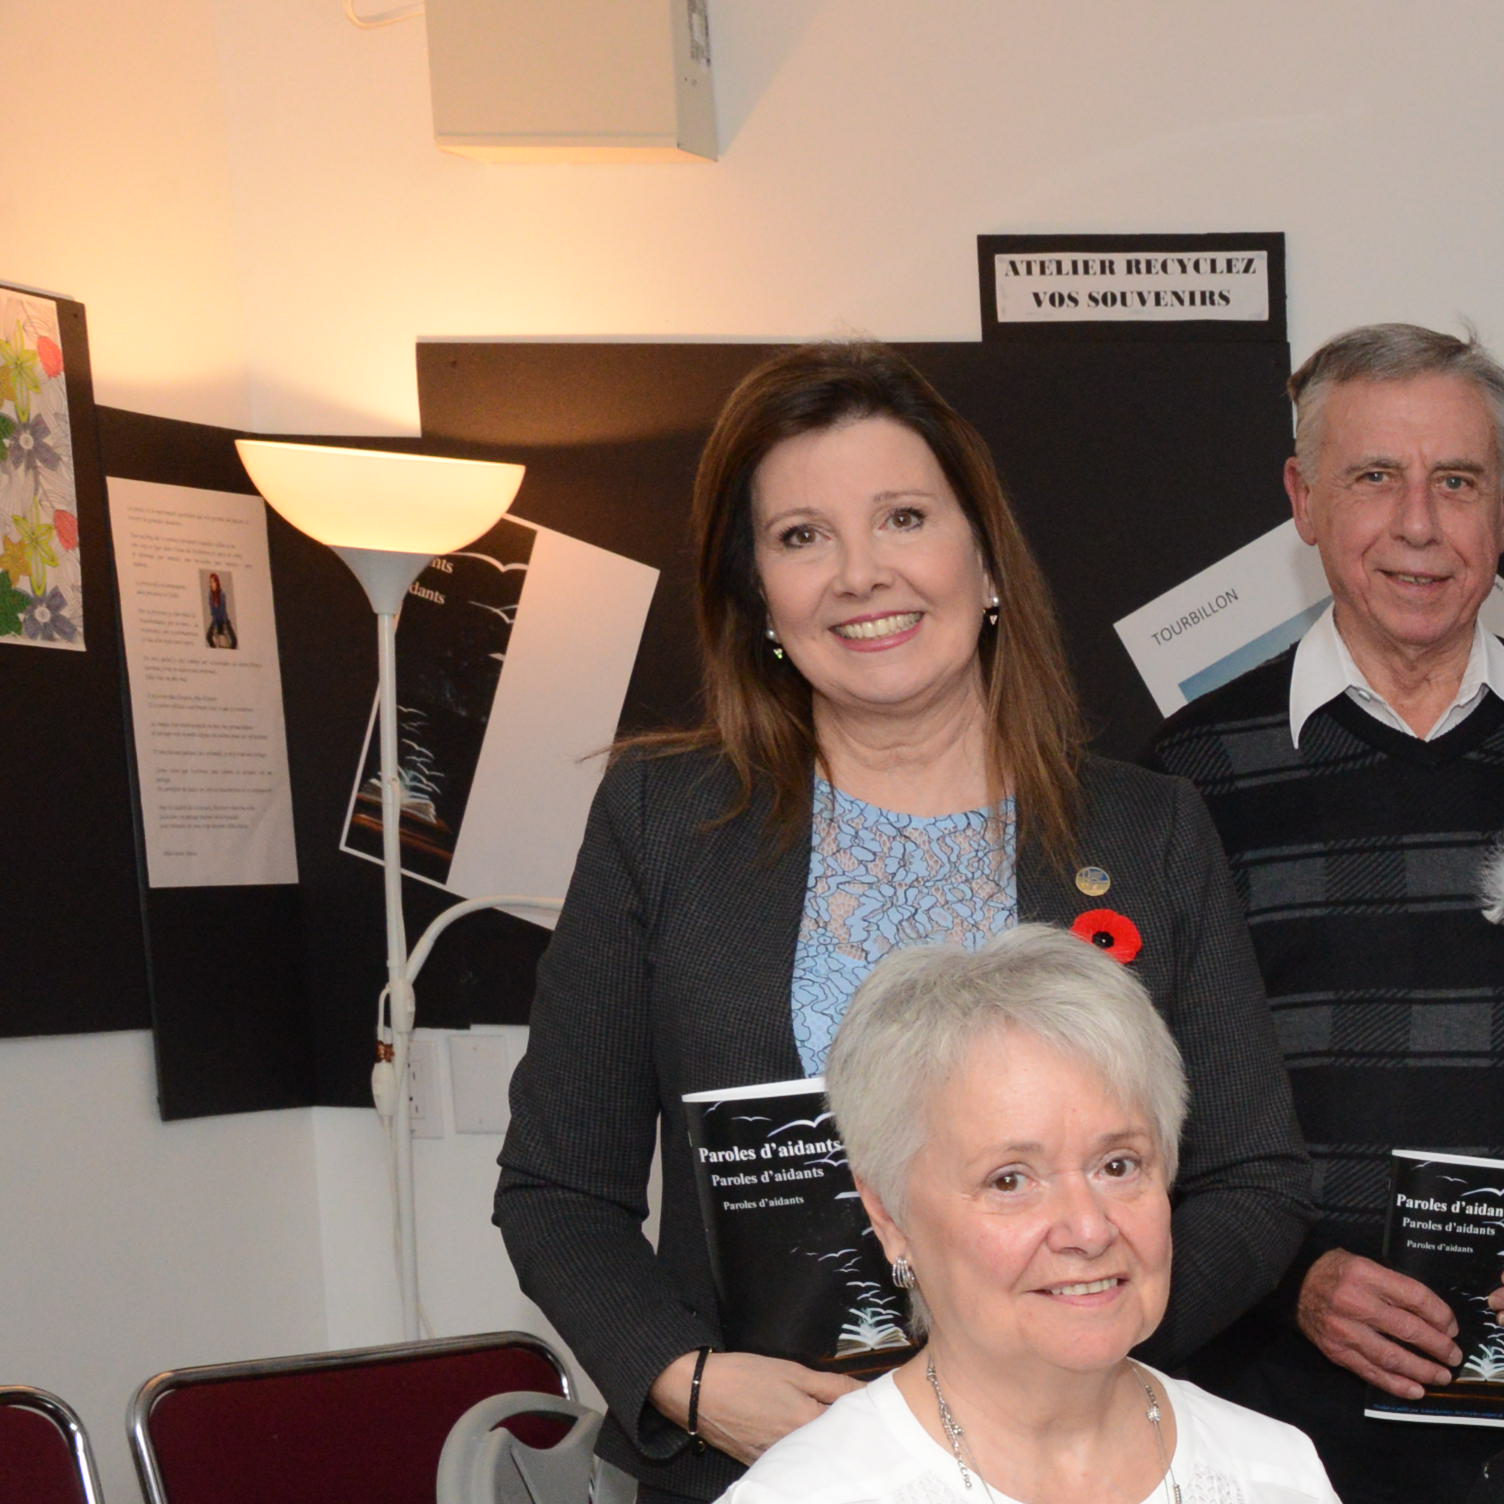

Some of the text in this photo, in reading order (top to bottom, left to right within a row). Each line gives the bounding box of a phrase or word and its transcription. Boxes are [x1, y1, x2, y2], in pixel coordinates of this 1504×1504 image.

[1005, 257, 1257, 277] ATELIER RECYCLEZ
[1032, 289, 1231, 308] VOS SOUVENIRS
[1151, 588, 1239, 646] TOURBILLON
[699, 1137, 842, 1164] Paroles d'aidants
[711, 1167, 825, 1187] Paroles d'aidants
[723, 1195, 805, 1211] Paroles d'aidants
[1396, 1193, 1448, 1213] Paroles
[1402, 1217, 1496, 1236] Paroles d'aidants
[1406, 1239, 1474, 1254] Paroles d'aidants
